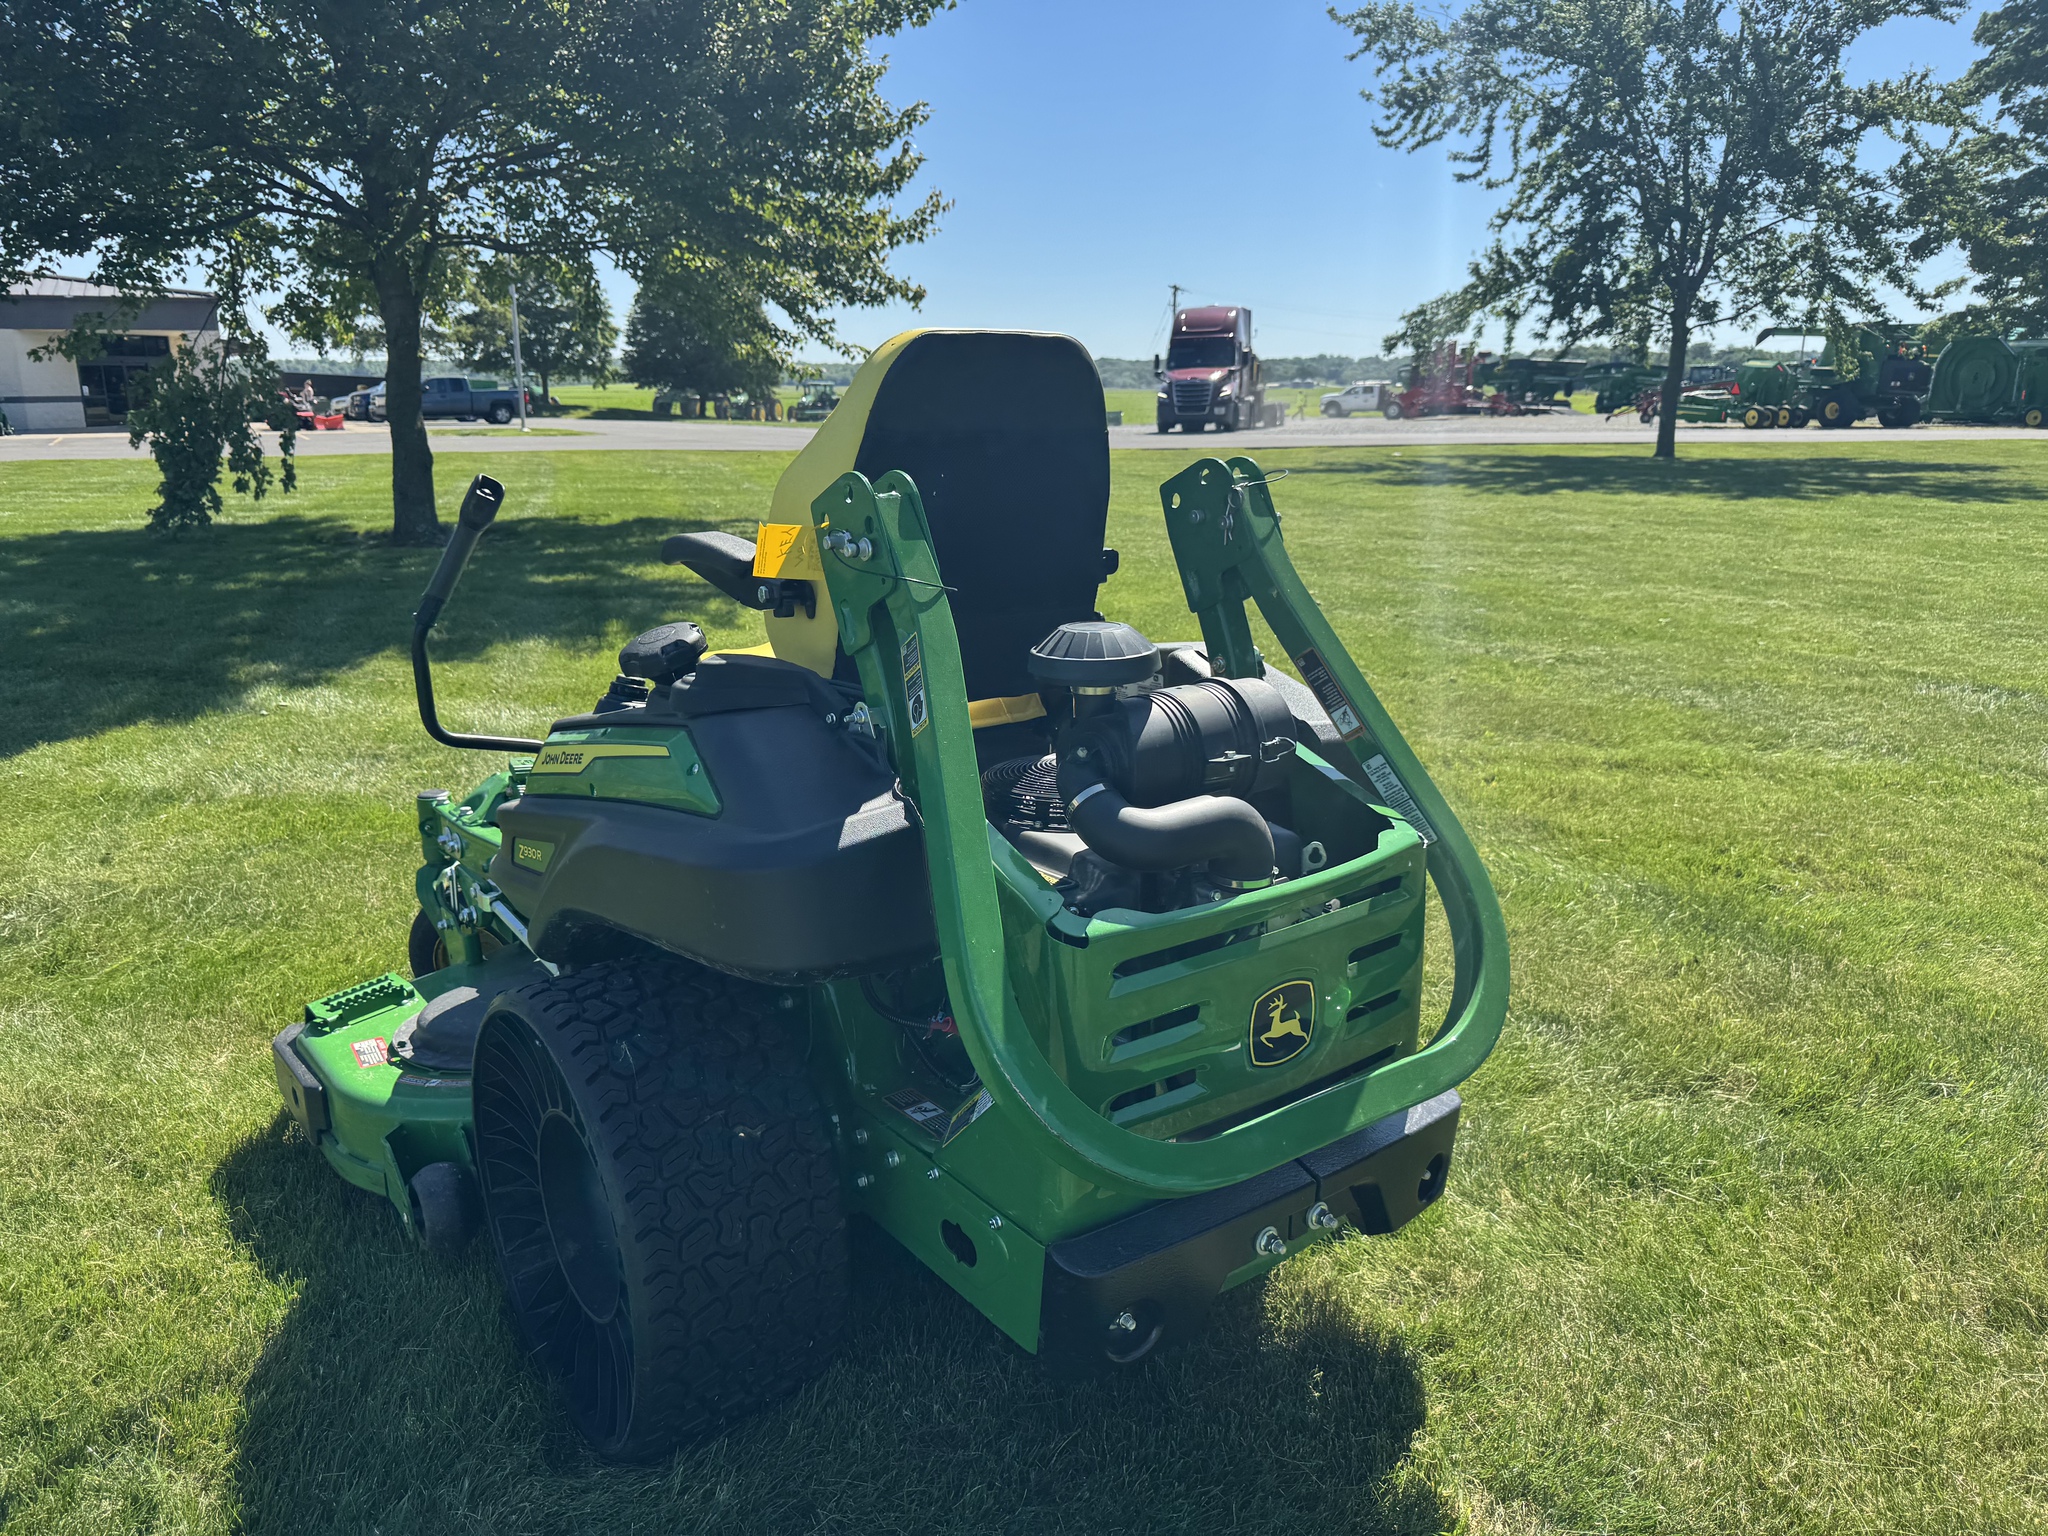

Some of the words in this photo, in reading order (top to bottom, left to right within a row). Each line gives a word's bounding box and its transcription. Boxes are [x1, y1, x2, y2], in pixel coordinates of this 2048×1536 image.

[541, 751, 560, 765] JOHN
[560, 751, 584, 765] DEERE
[518, 844, 542, 861] Z930R
